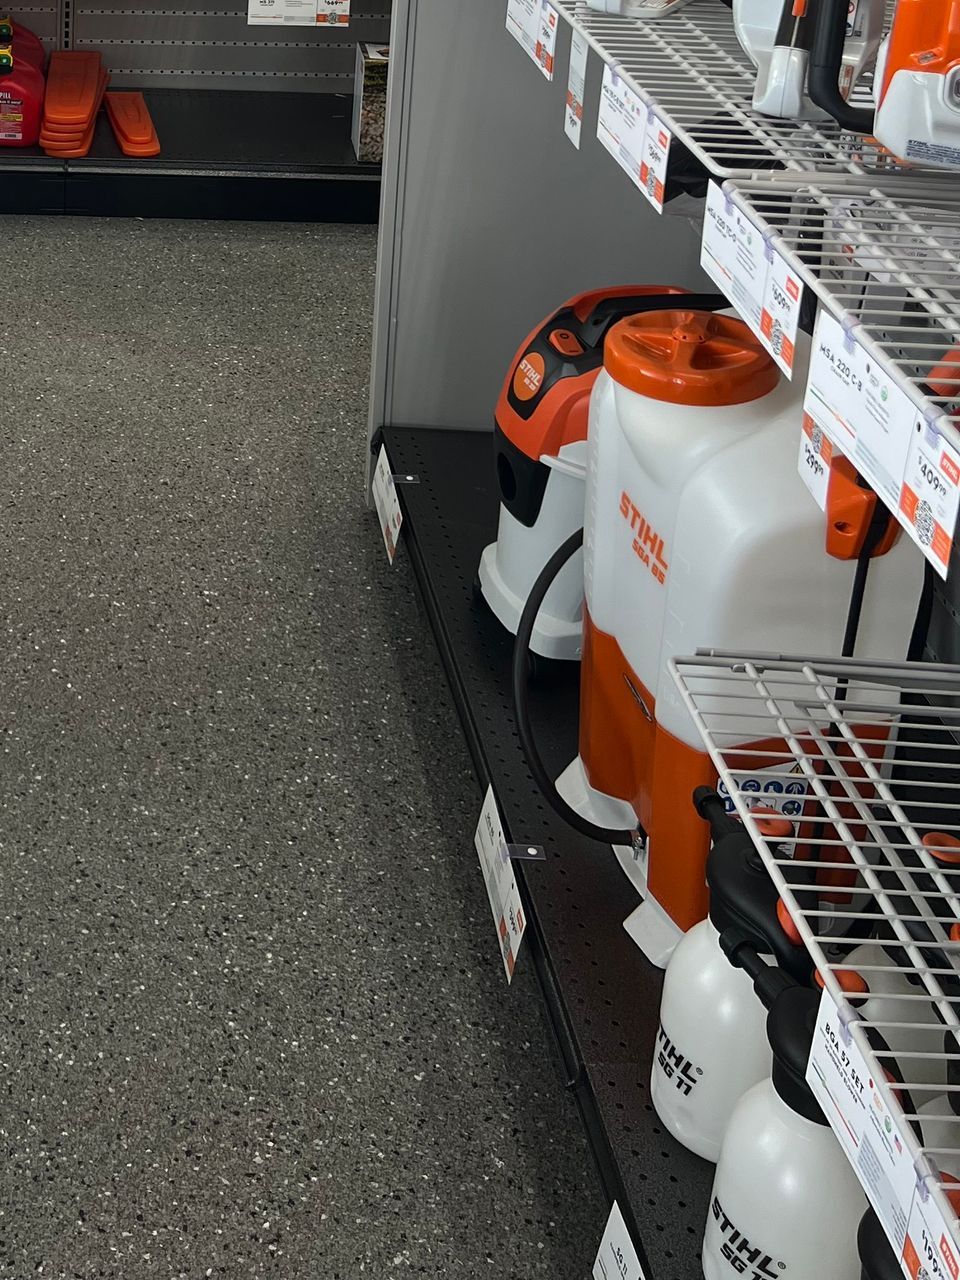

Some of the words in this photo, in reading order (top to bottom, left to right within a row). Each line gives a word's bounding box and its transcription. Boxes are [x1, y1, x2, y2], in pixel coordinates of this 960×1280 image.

[519, 360, 542, 386] STIHL
[821, 344, 834, 362] MSA
[837, 358, 850, 377] 220
[942, 458, 958, 482] STIHL
[619, 490, 669, 570] STIHL
[631, 538, 650, 568] SGA
[651, 564, 665, 585] 85
[658, 1050, 675, 1079] SG
[676, 1075, 693, 1097] 11
[825, 1021, 840, 1052] BGA
[840, 1050, 851, 1068] 57
[851, 1068, 865, 1094] SET
[711, 1195, 779, 1280] STIHL
[719, 1242, 748, 1274] SG
